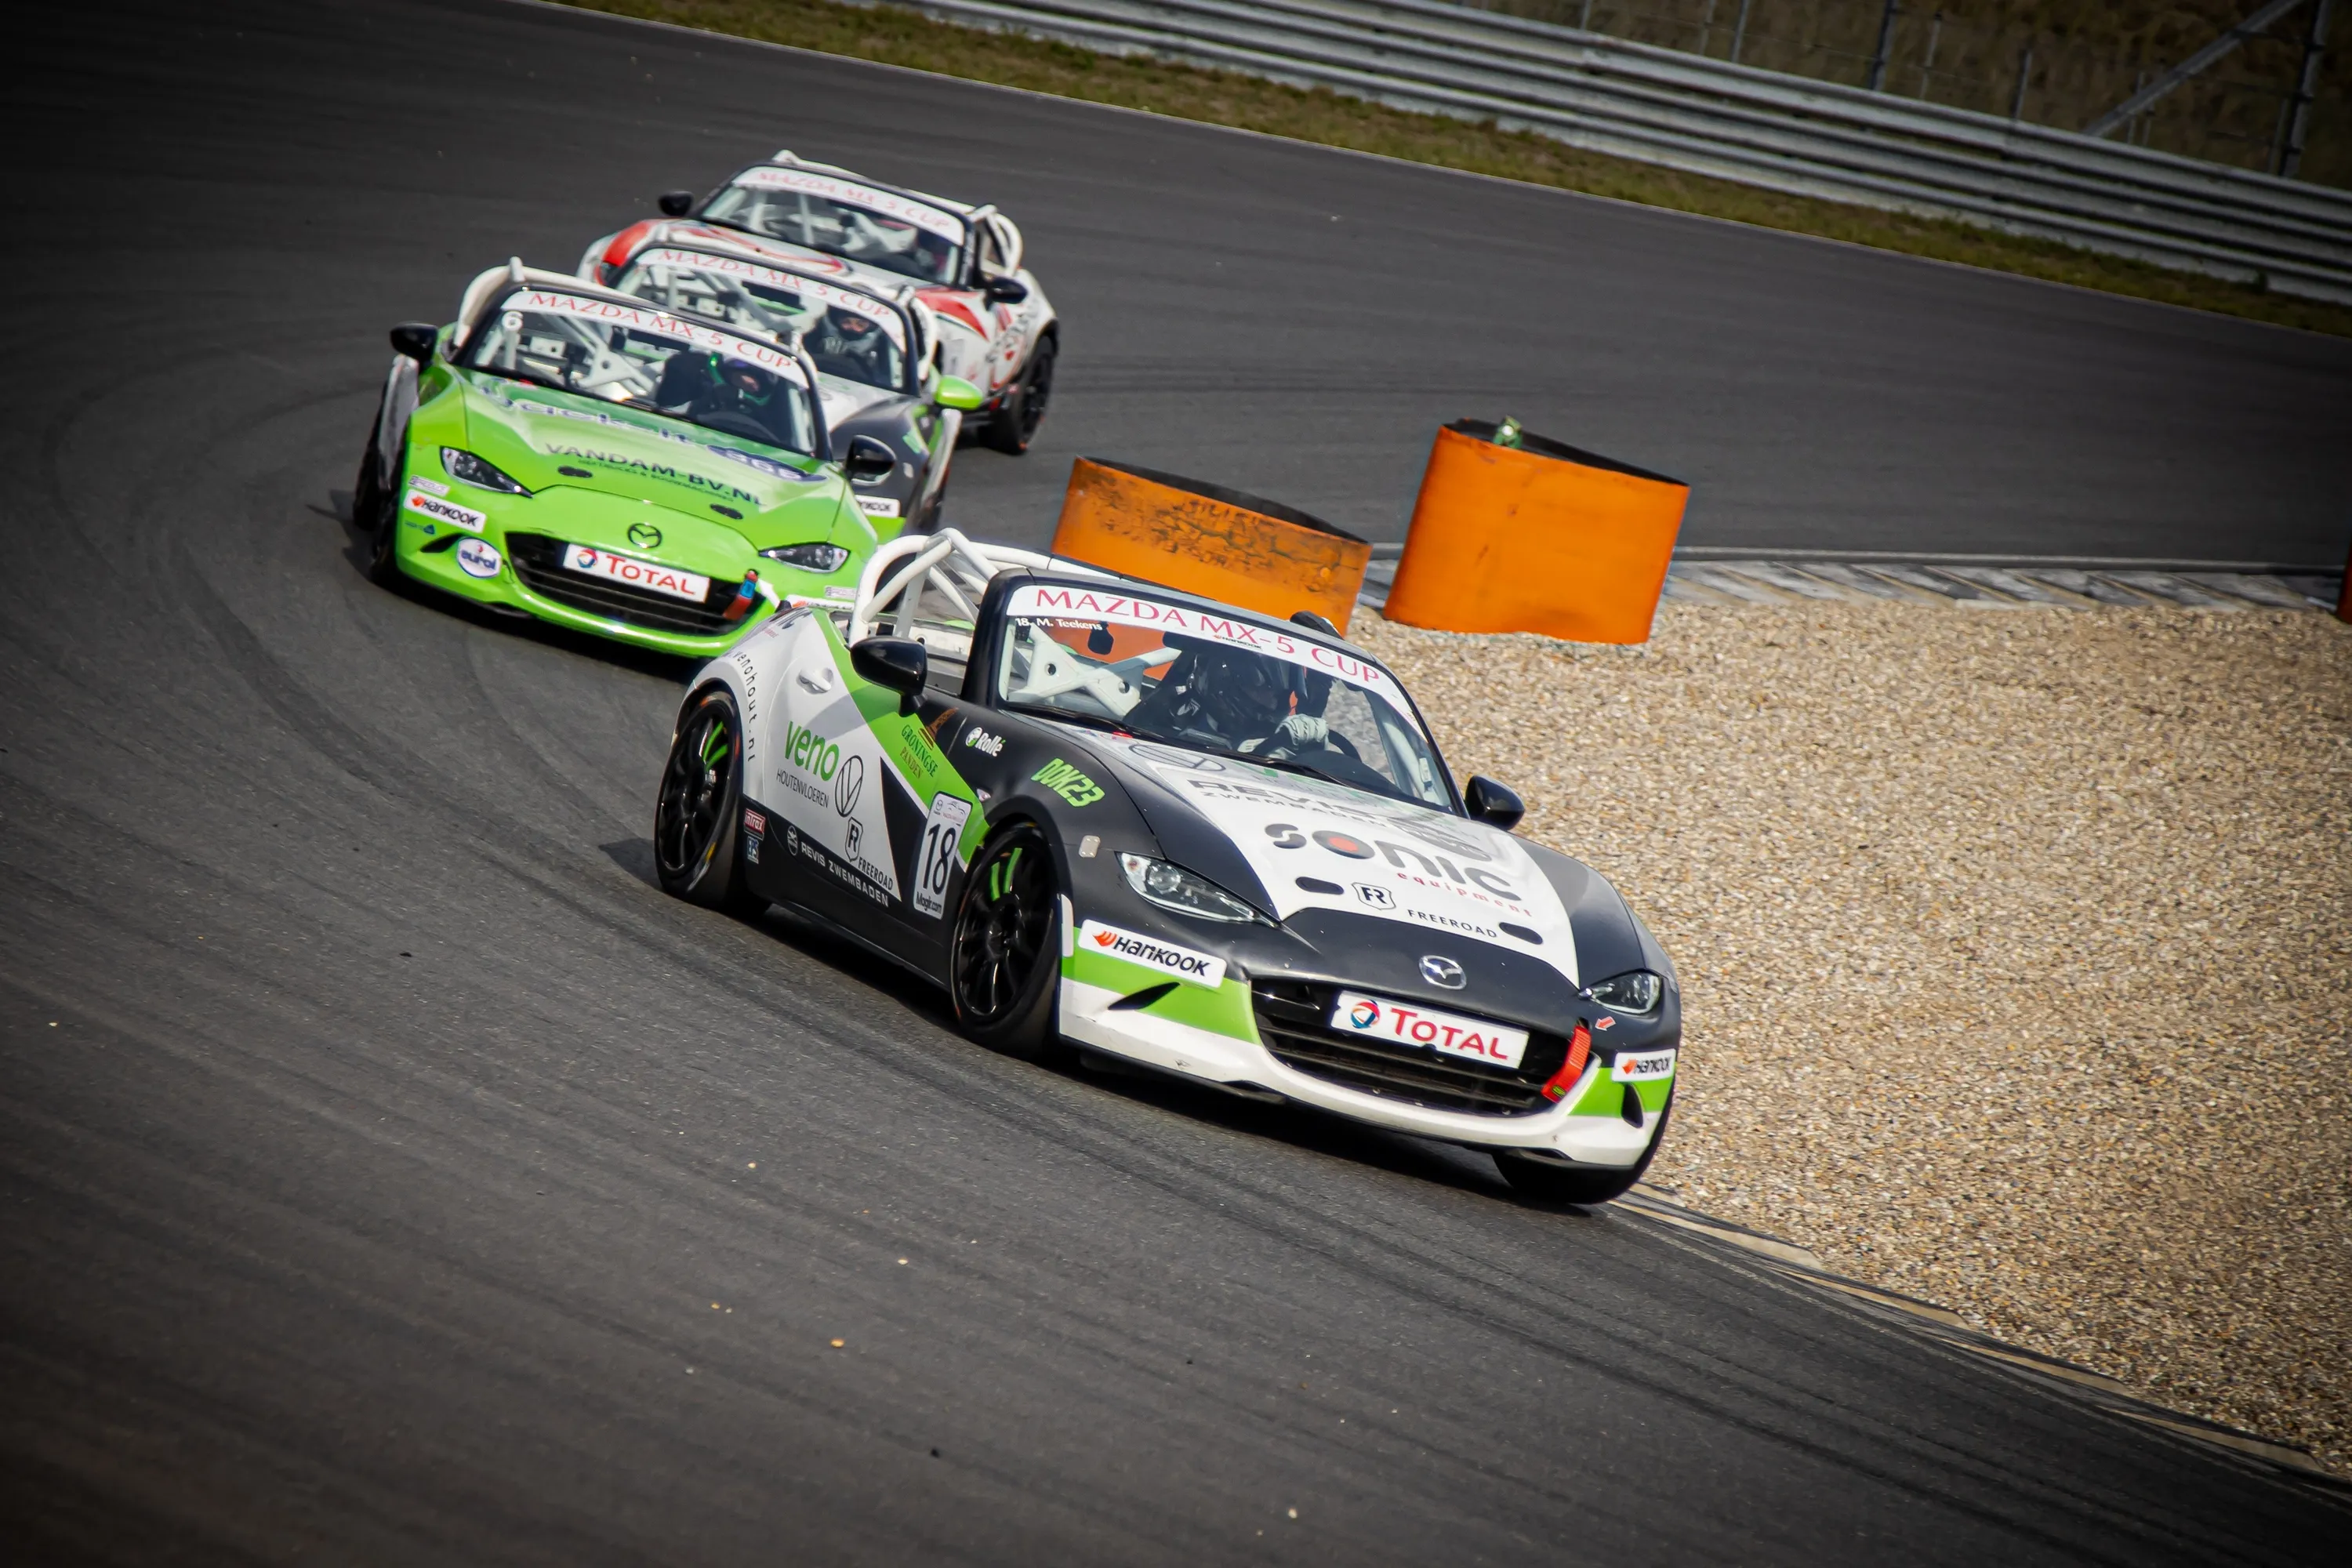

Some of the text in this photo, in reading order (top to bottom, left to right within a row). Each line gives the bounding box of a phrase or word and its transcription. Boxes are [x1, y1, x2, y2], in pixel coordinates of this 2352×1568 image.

[905, 206, 949, 227] CUP
[659, 250, 754, 276] MAZDA
[840, 293, 890, 316] CUP
[528, 293, 792, 368] MAZDA MX-5 CUP
[546, 442, 764, 506] VANDAM-BV.NL
[461, 550, 497, 570] eurol
[607, 554, 695, 596] TOTAL
[1036, 619, 1053, 627] M.
[1056, 619, 1103, 630] Teekens
[1036, 589, 1379, 682] MAZDA MX-5 CUP
[785, 720, 839, 782] veno
[899, 747, 924, 779] PANDEN
[902, 724, 938, 777] GRONINGSE
[975, 732, 1006, 757] Rollé
[776, 768, 829, 808] HOUTENVLOEREN
[1189, 779, 1374, 818] REVIS
[1203, 791, 1386, 827] ZWEMBADEN
[800, 842, 889, 907] REVIS ZWEMBADEN
[858, 857, 893, 891] FREEROAD
[923, 823, 956, 895] 18
[1397, 873, 1532, 916] equipment
[1407, 909, 1497, 938] FREEROAD
[1391, 1007, 1508, 1060] TOTAL
